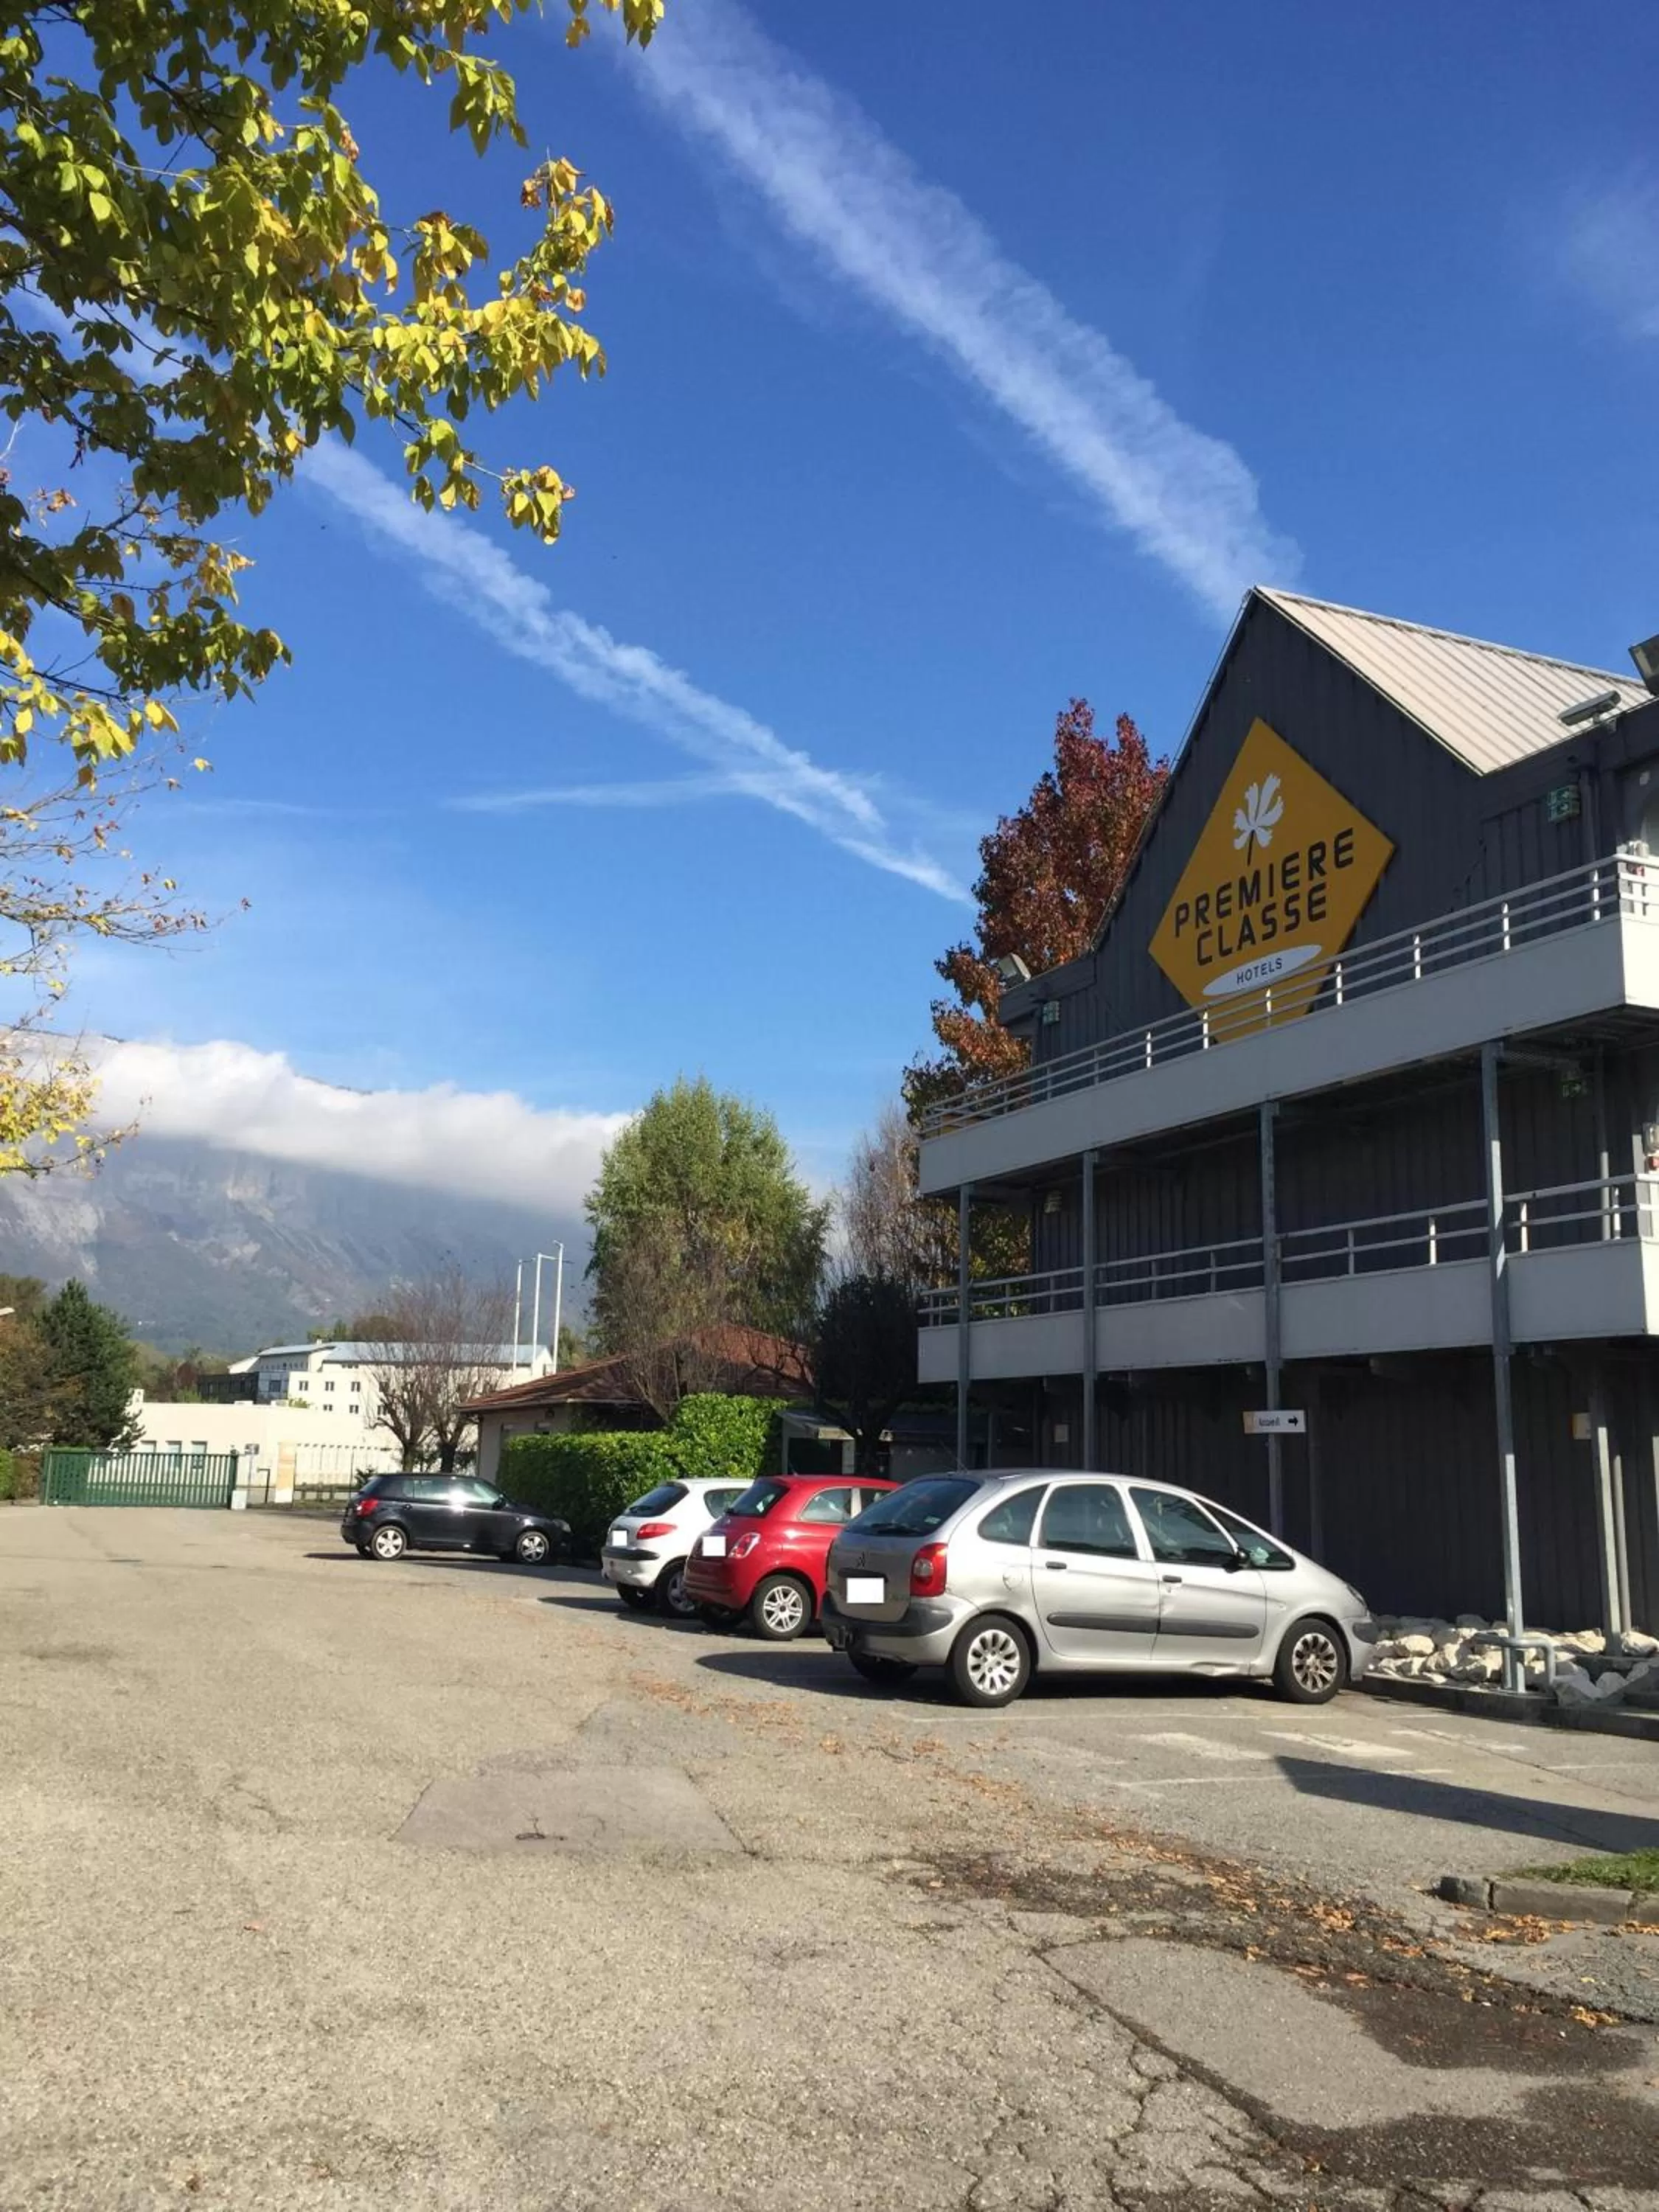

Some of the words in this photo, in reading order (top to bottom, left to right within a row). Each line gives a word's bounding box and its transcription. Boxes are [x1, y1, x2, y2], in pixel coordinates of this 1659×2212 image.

[1175, 827, 1354, 938] PREMIERE
[1197, 883, 1327, 966] CLASSE
[1236, 958, 1283, 984] HOTELS
